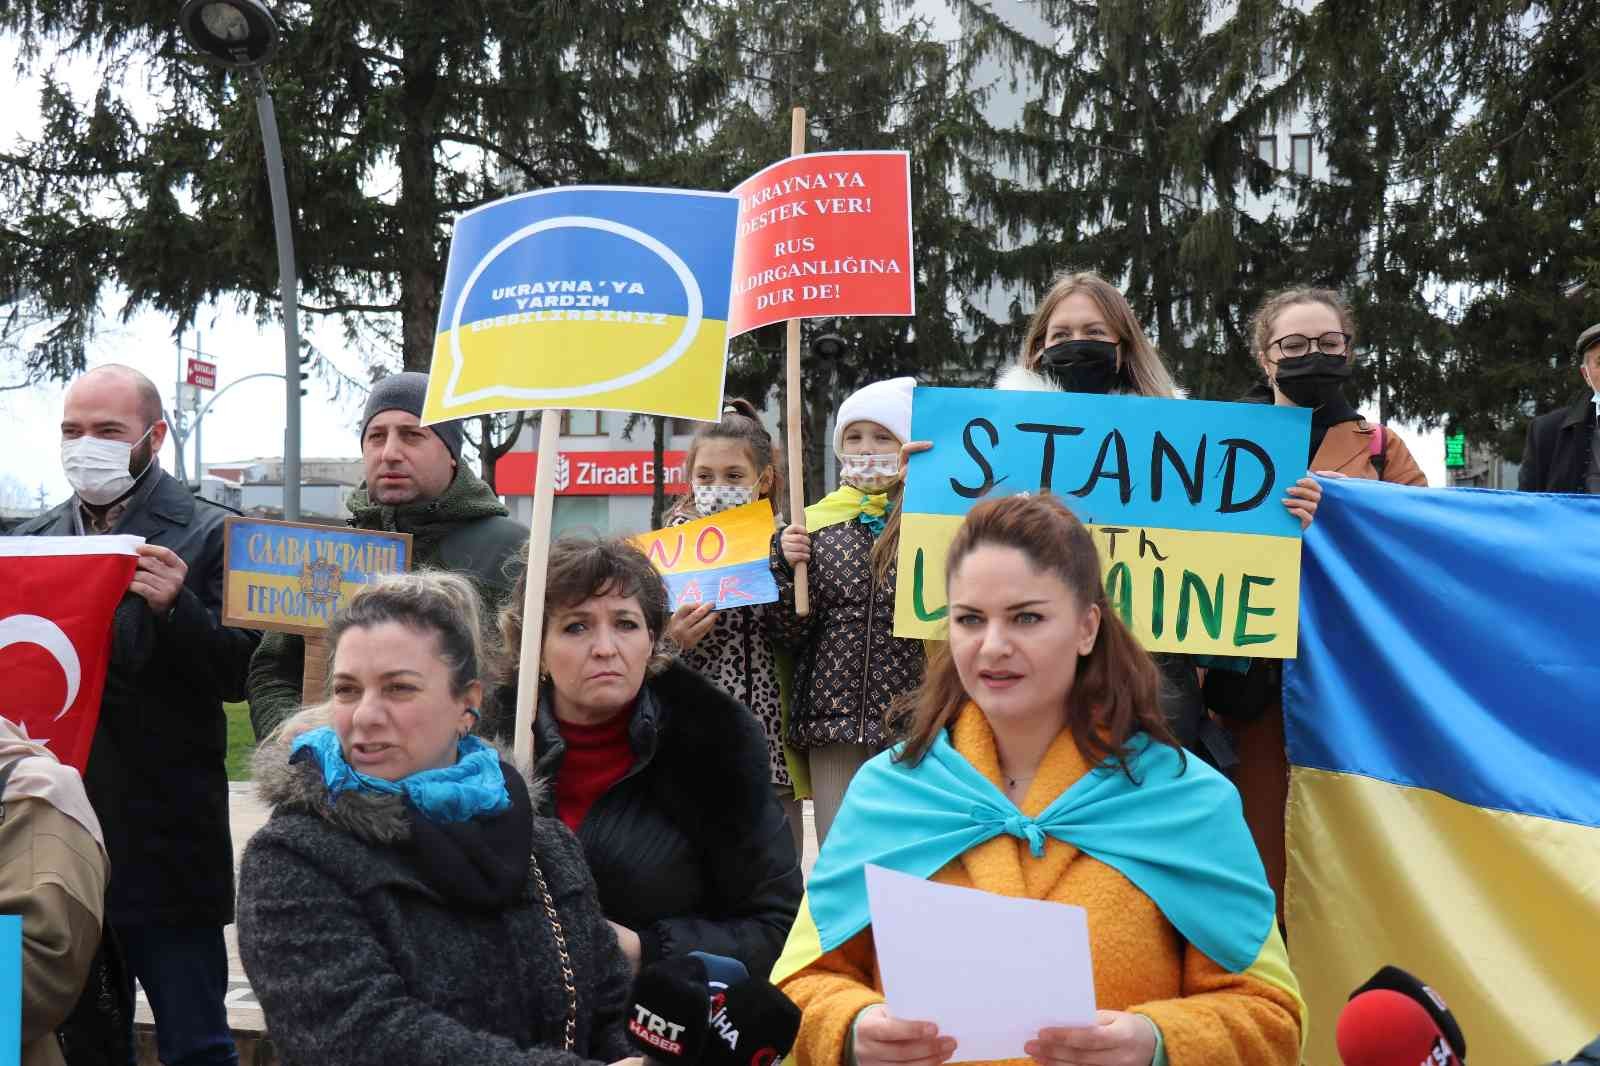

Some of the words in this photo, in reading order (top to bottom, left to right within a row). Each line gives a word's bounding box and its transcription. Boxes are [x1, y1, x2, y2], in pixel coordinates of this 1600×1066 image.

[741, 172, 865, 213] UKRAYNA'YA
[740, 200, 809, 237] DESTEK
[814, 197, 872, 214] VER!
[774, 237, 815, 257] RUS
[491, 279, 645, 300] UKRAYNA'YA
[731, 257, 901, 296] ALDIRGANLIĞINA
[515, 295, 609, 310] YARDIM
[756, 288, 794, 310] DUR
[802, 284, 841, 300] DE!
[575, 461, 639, 485] Ziraat
[949, 417, 1276, 513] STAND
[248, 533, 312, 567] СЛАВА
[648, 526, 725, 569] NO
[677, 575, 753, 605] AR
[913, 547, 1278, 647] UAINE
[629, 1020, 682, 1055] HABER
[634, 1003, 686, 1041] TRT
